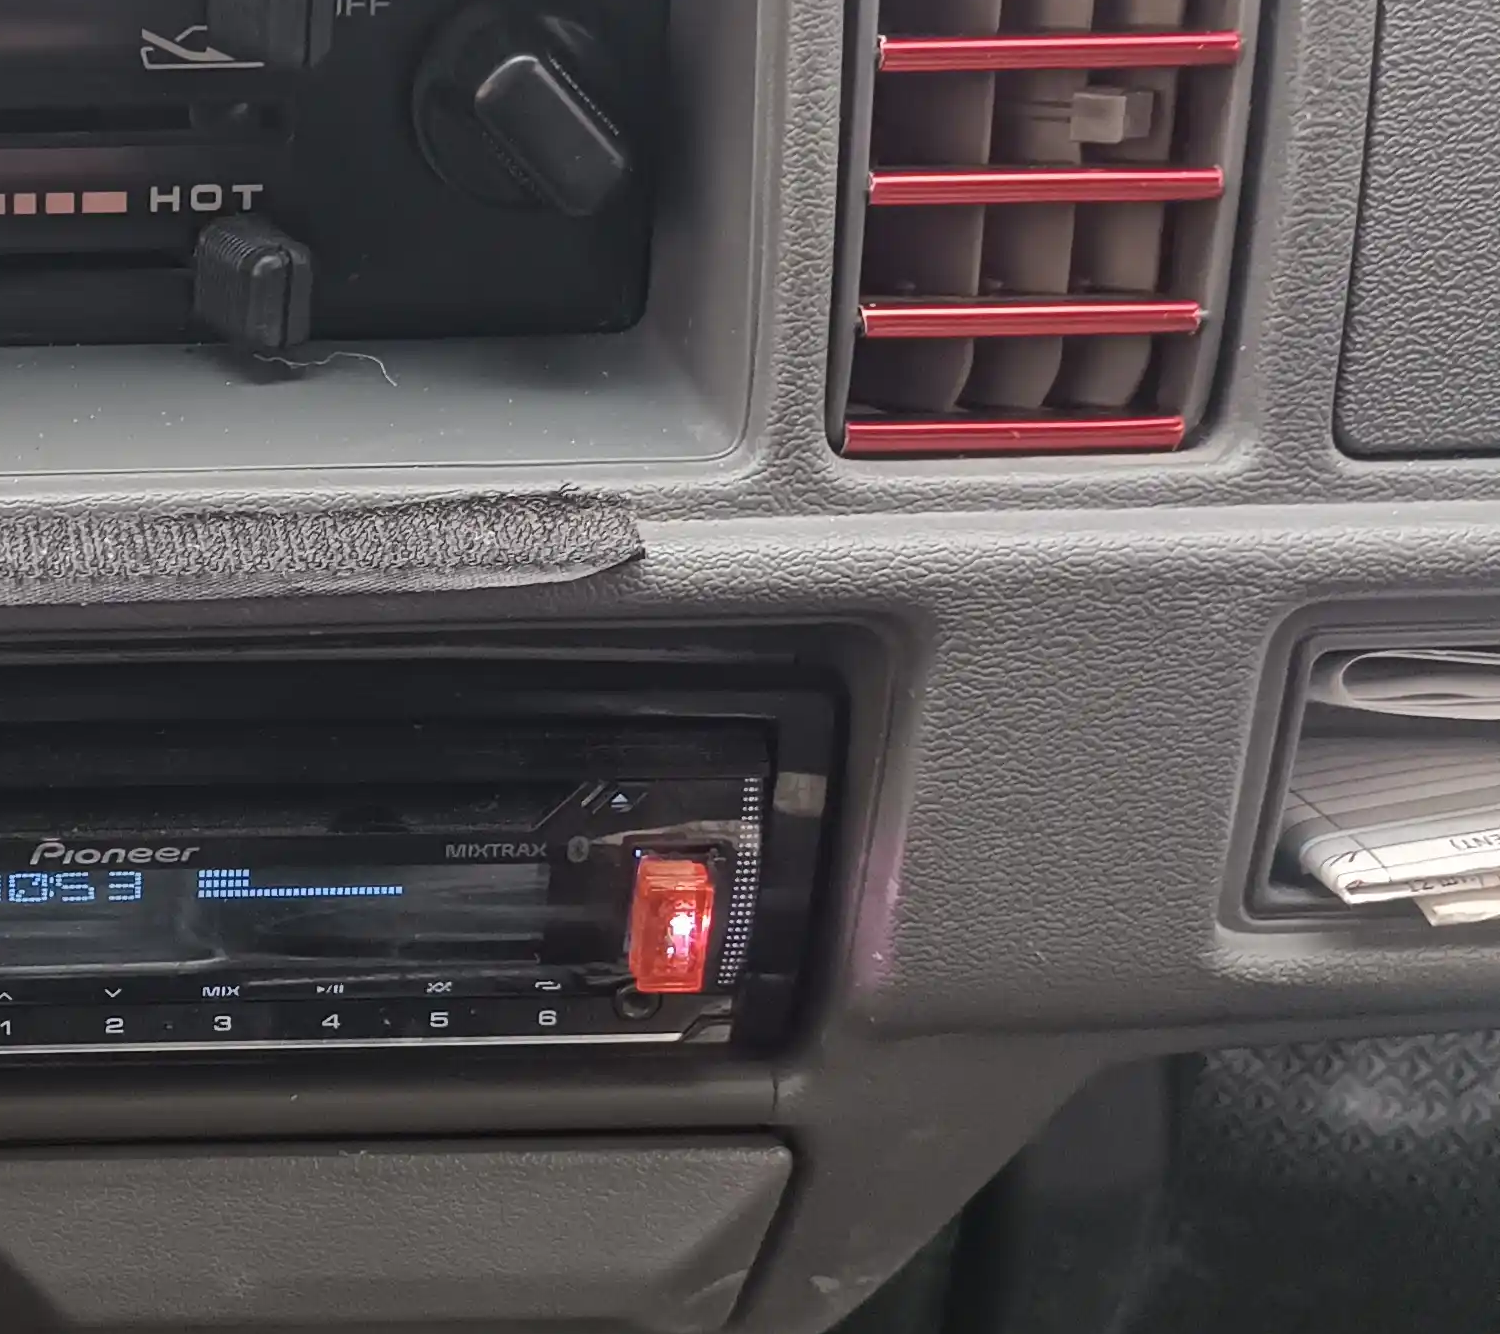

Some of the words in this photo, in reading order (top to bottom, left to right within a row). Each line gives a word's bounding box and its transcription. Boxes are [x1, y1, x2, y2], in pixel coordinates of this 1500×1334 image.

[149, 183, 264, 213] HOT
[29, 837, 200, 865] Pioneer
[445, 842, 548, 859] MIXTRAX
[202, 985, 241, 998] MIX
[0, 1019, 12, 1037] 1
[104, 1017, 125, 1035] 2
[213, 1015, 233, 1033] 3
[321, 1013, 341, 1030] 4
[429, 1011, 450, 1028] 5
[538, 1009, 558, 1027] 6
